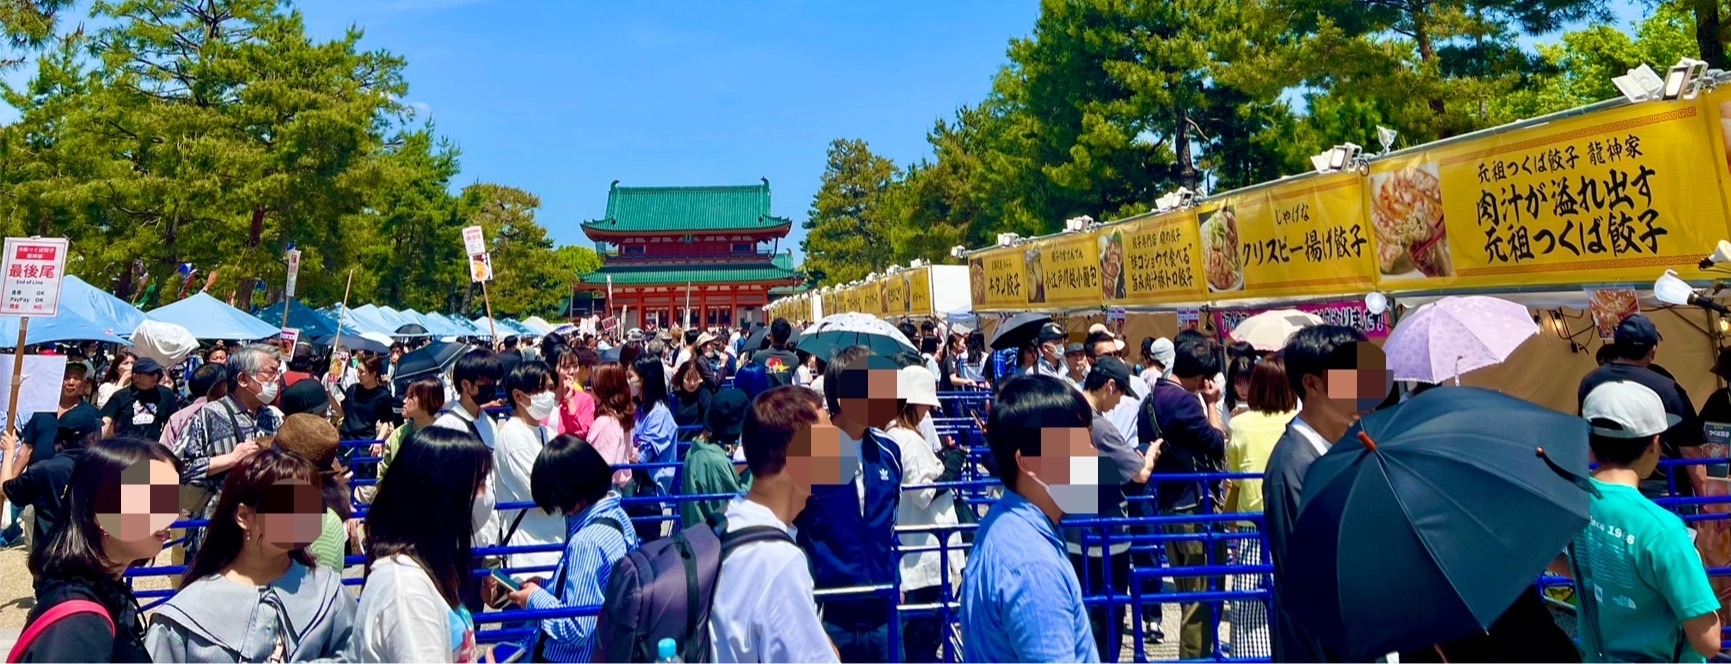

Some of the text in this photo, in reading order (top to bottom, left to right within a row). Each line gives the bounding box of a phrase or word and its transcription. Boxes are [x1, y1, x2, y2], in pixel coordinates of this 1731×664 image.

[1477, 133, 1644, 184] 元祖つくば餃子 龍神家
[1275, 203, 1310, 226] じゃげな
[1476, 165, 1656, 227] 肉汁が溢れ出す
[1242, 223, 1368, 267] クリスピー揚げ餃子
[1484, 208, 1668, 265] 元祖つくば餃子
[9, 264, 55, 279] 最後尾
